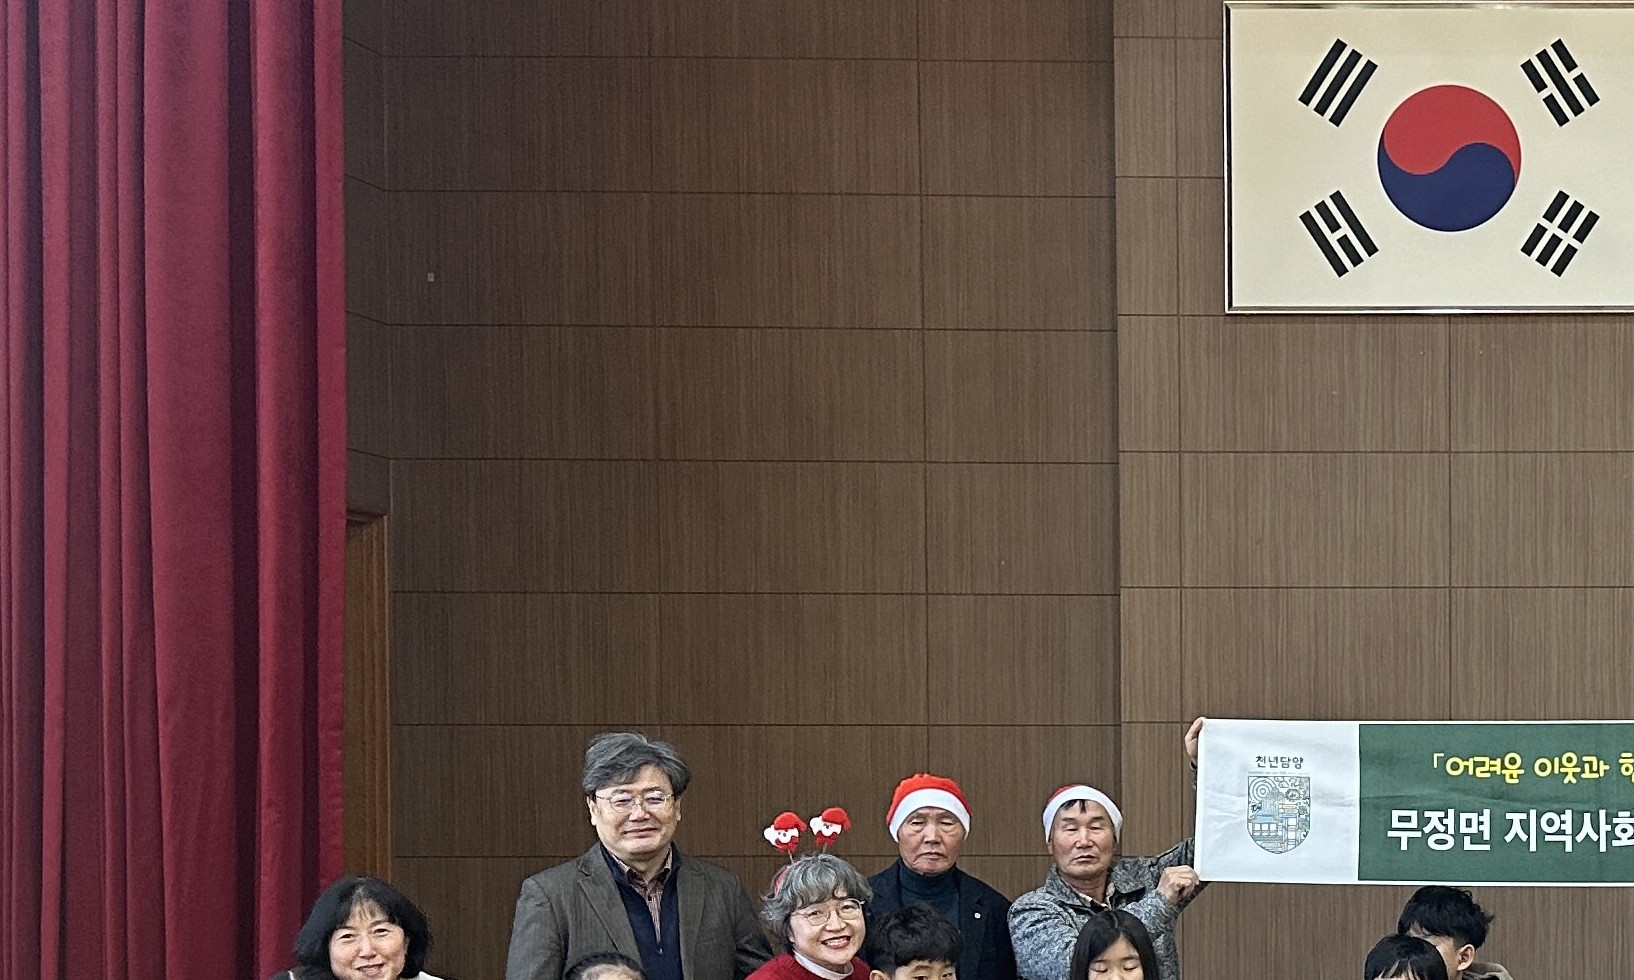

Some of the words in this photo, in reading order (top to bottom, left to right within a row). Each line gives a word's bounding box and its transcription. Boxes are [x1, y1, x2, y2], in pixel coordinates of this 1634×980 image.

[1255, 755, 1304, 769] 천년담양
[1534, 752, 1610, 784] 이웃과
[1387, 808, 1491, 851] 무정면
